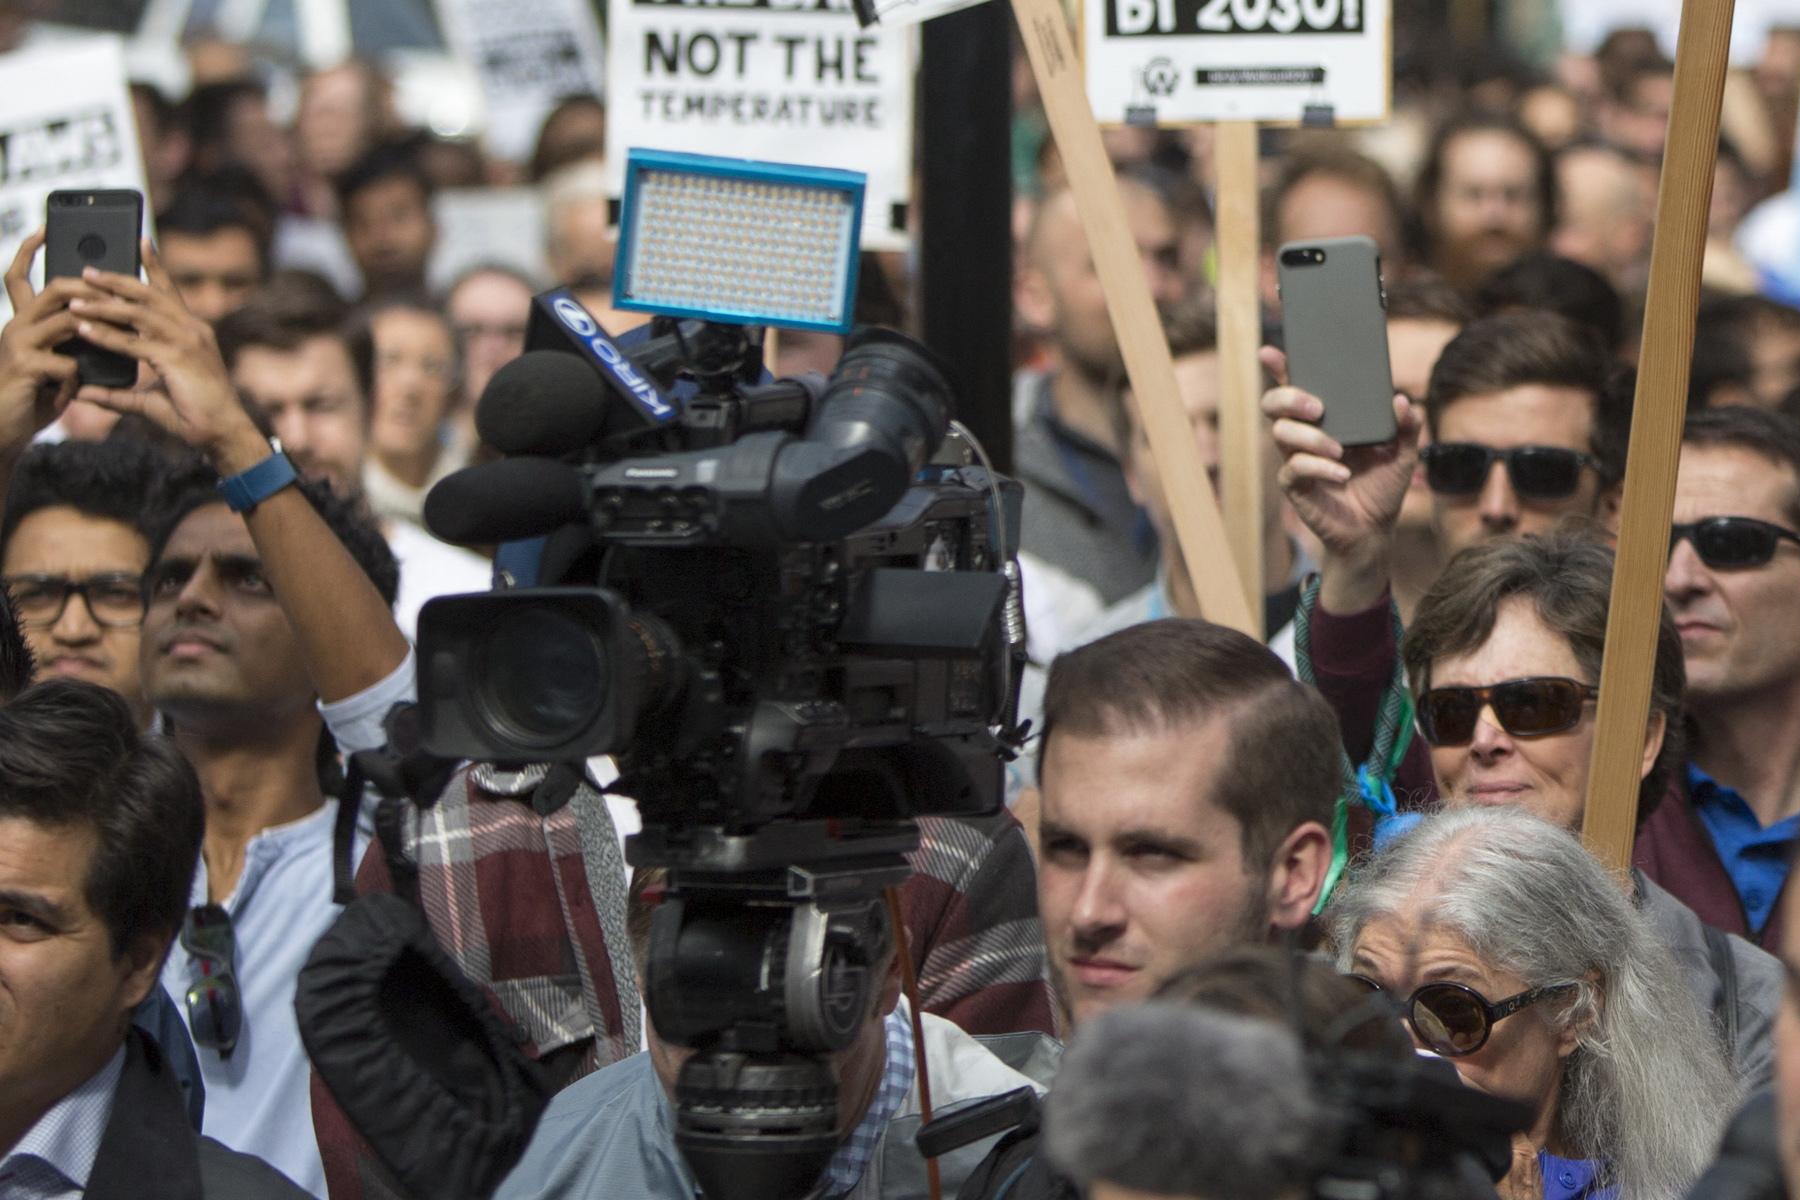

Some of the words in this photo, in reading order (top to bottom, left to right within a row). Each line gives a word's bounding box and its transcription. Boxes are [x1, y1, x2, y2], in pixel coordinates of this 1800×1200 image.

[643, 31, 759, 77] NOT
[773, 36, 881, 83] THE
[641, 88, 883, 128] TEMPERATURE
[592, 338, 671, 415] KIRO
